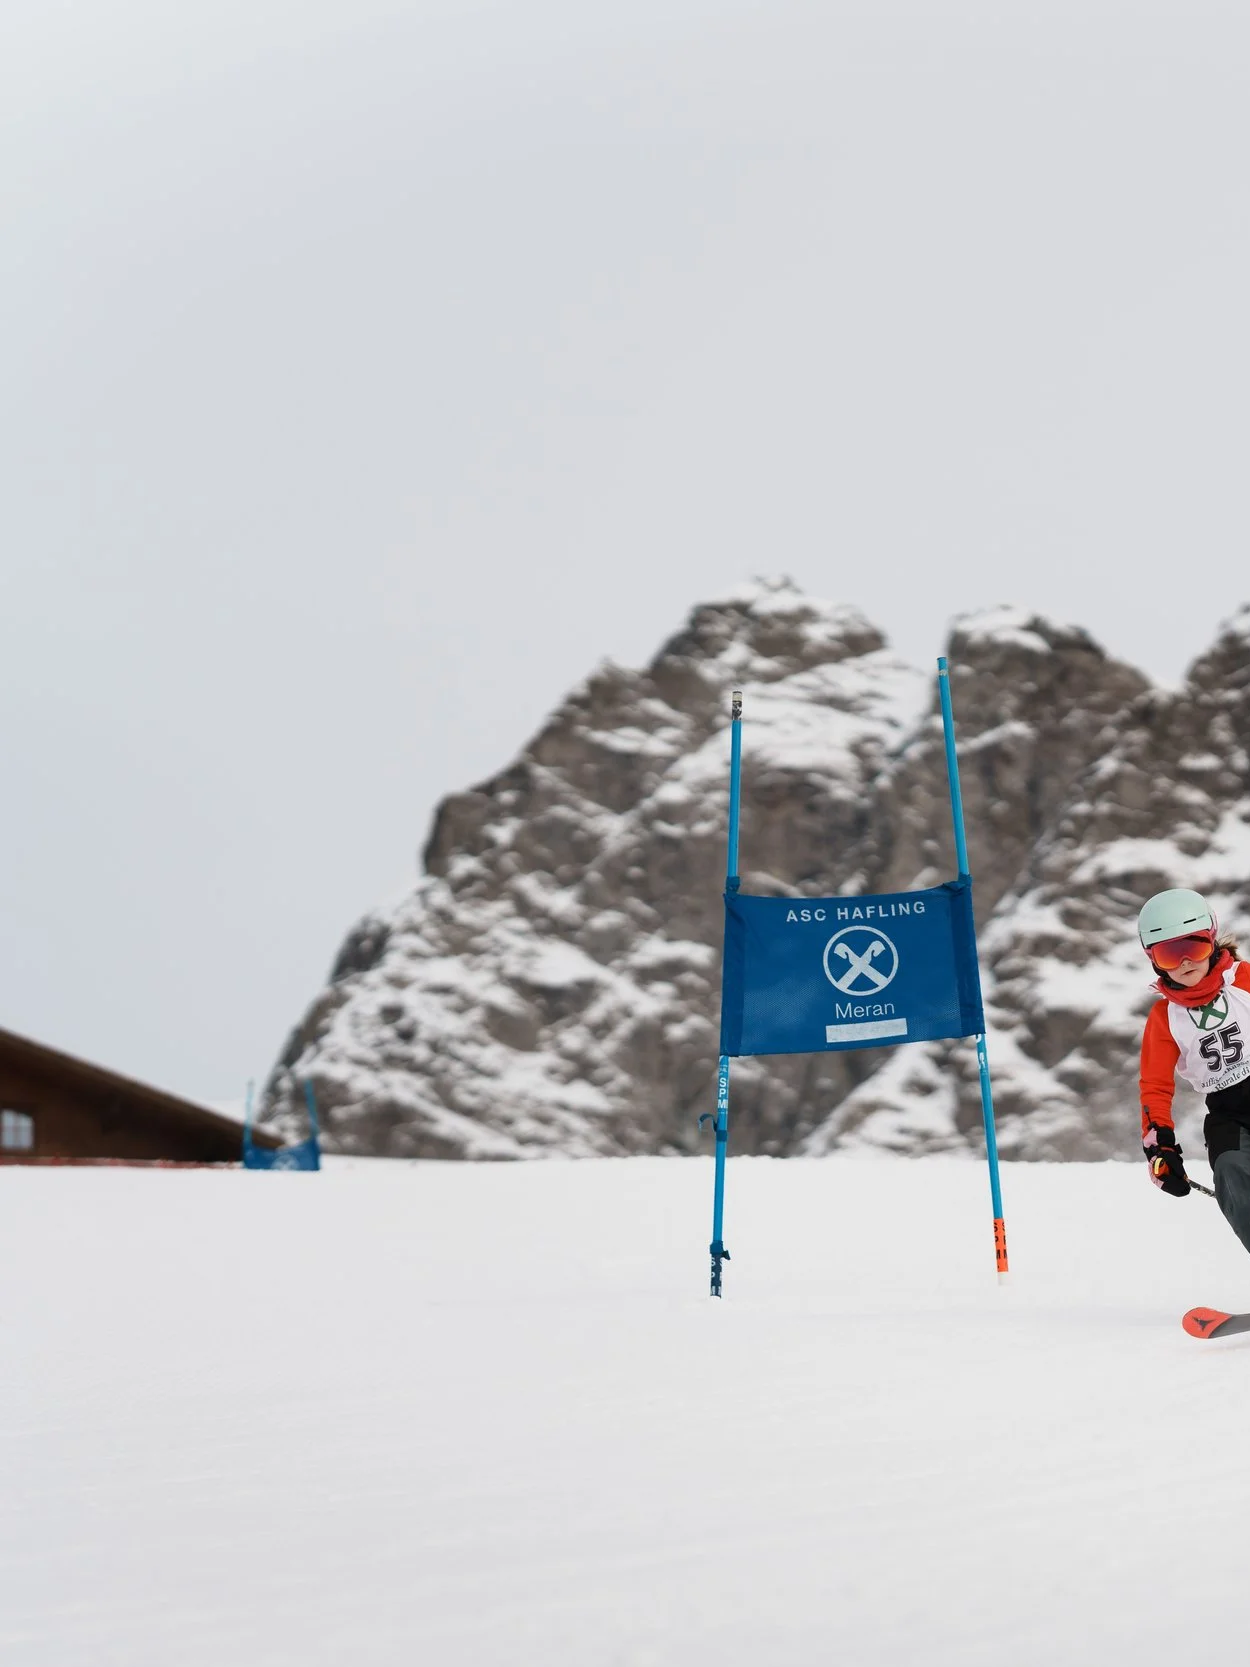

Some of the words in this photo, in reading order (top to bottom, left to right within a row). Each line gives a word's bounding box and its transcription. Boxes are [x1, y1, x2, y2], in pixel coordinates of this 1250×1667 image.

[786, 908, 827, 923] ASC
[837, 901, 926, 920] HAFLING
[835, 1002, 895, 1019] Meran
[1199, 1021, 1245, 1073] 55
[1241, 1066, 1250, 1076] di
